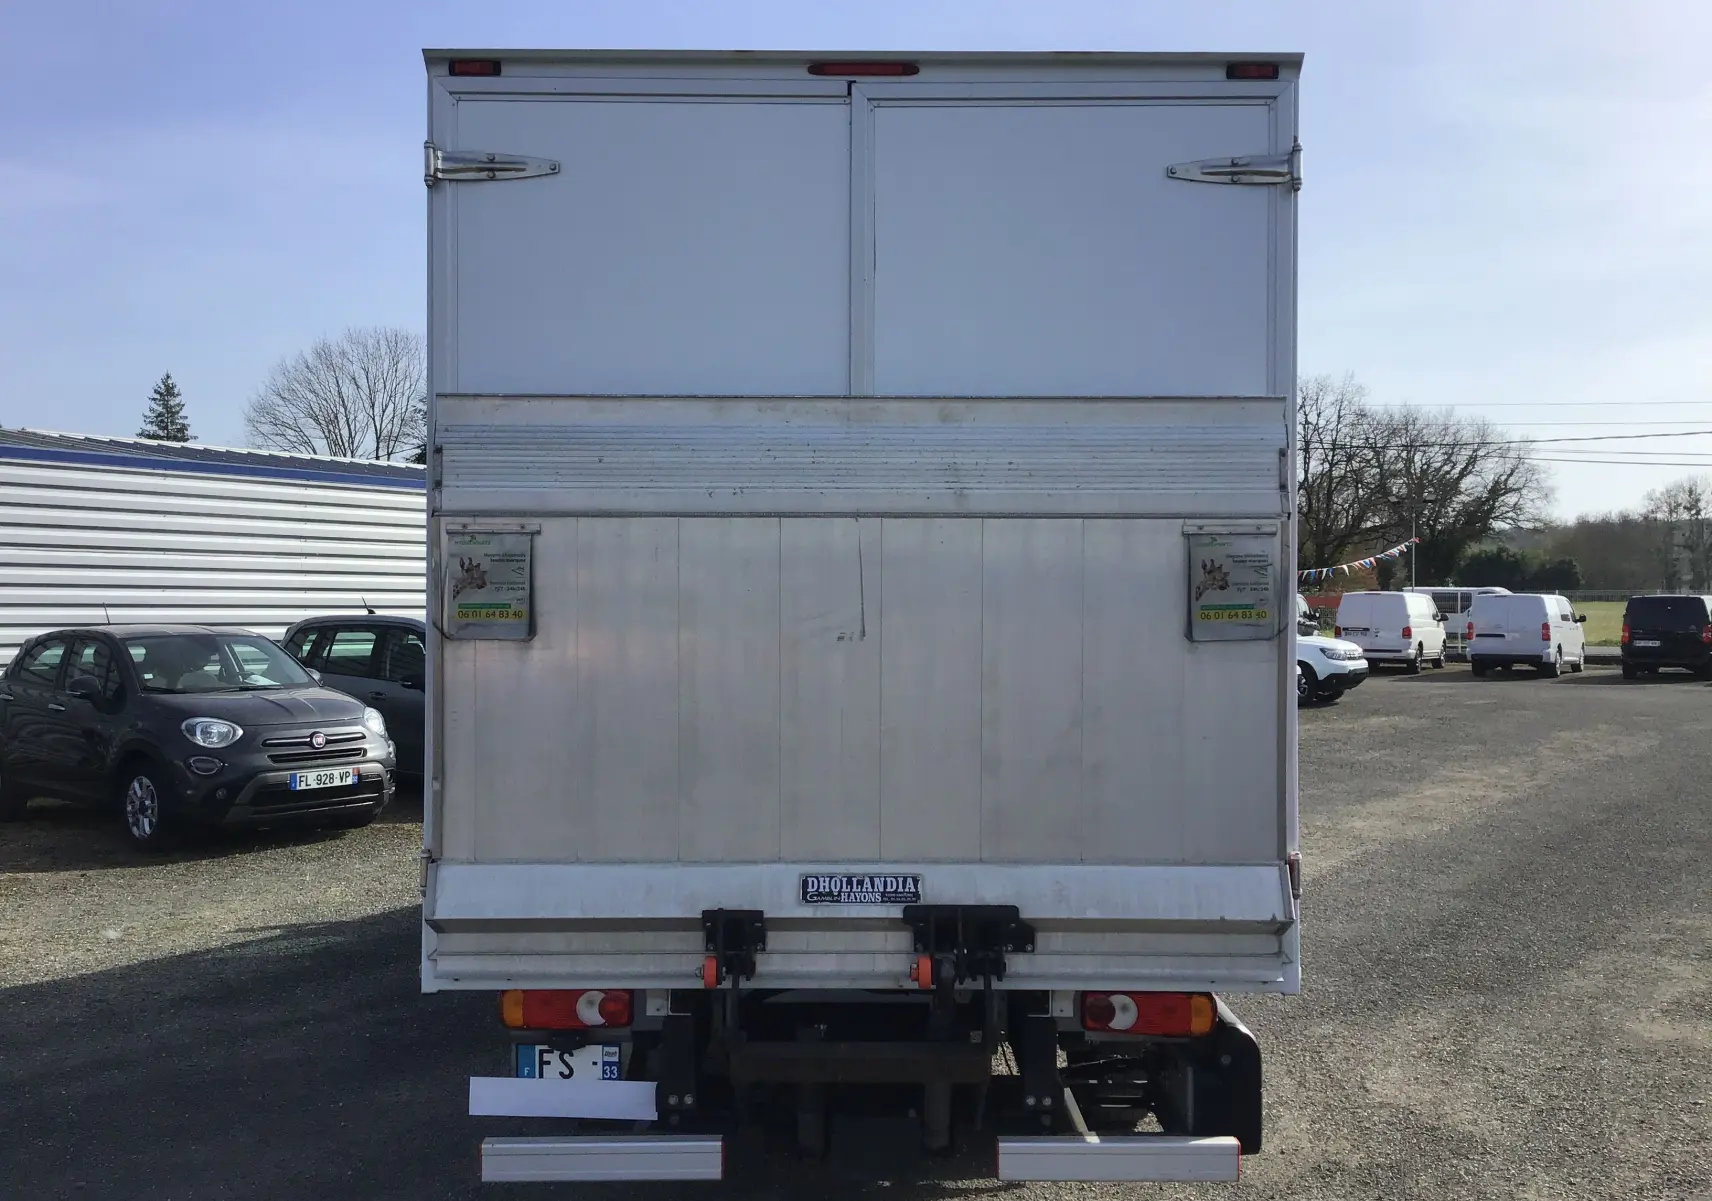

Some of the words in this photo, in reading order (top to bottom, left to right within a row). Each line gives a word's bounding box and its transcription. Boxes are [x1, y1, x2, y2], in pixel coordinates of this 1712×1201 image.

[458, 610, 469, 619] 06
[472, 610, 482, 619] 01
[485, 610, 496, 619] 64
[500, 610, 509, 619] 83
[512, 610, 523, 619] 40
[1200, 612, 1211, 620] 06
[1215, 611, 1224, 620] 01
[1228, 611, 1238, 619] 64
[1242, 611, 1252, 619] 83
[807, 877, 916, 892] DHOLLANDIA
[840, 892, 882, 902] HAYONS
[524, 1067, 530, 1076] F
[603, 1066, 618, 1078] 33
